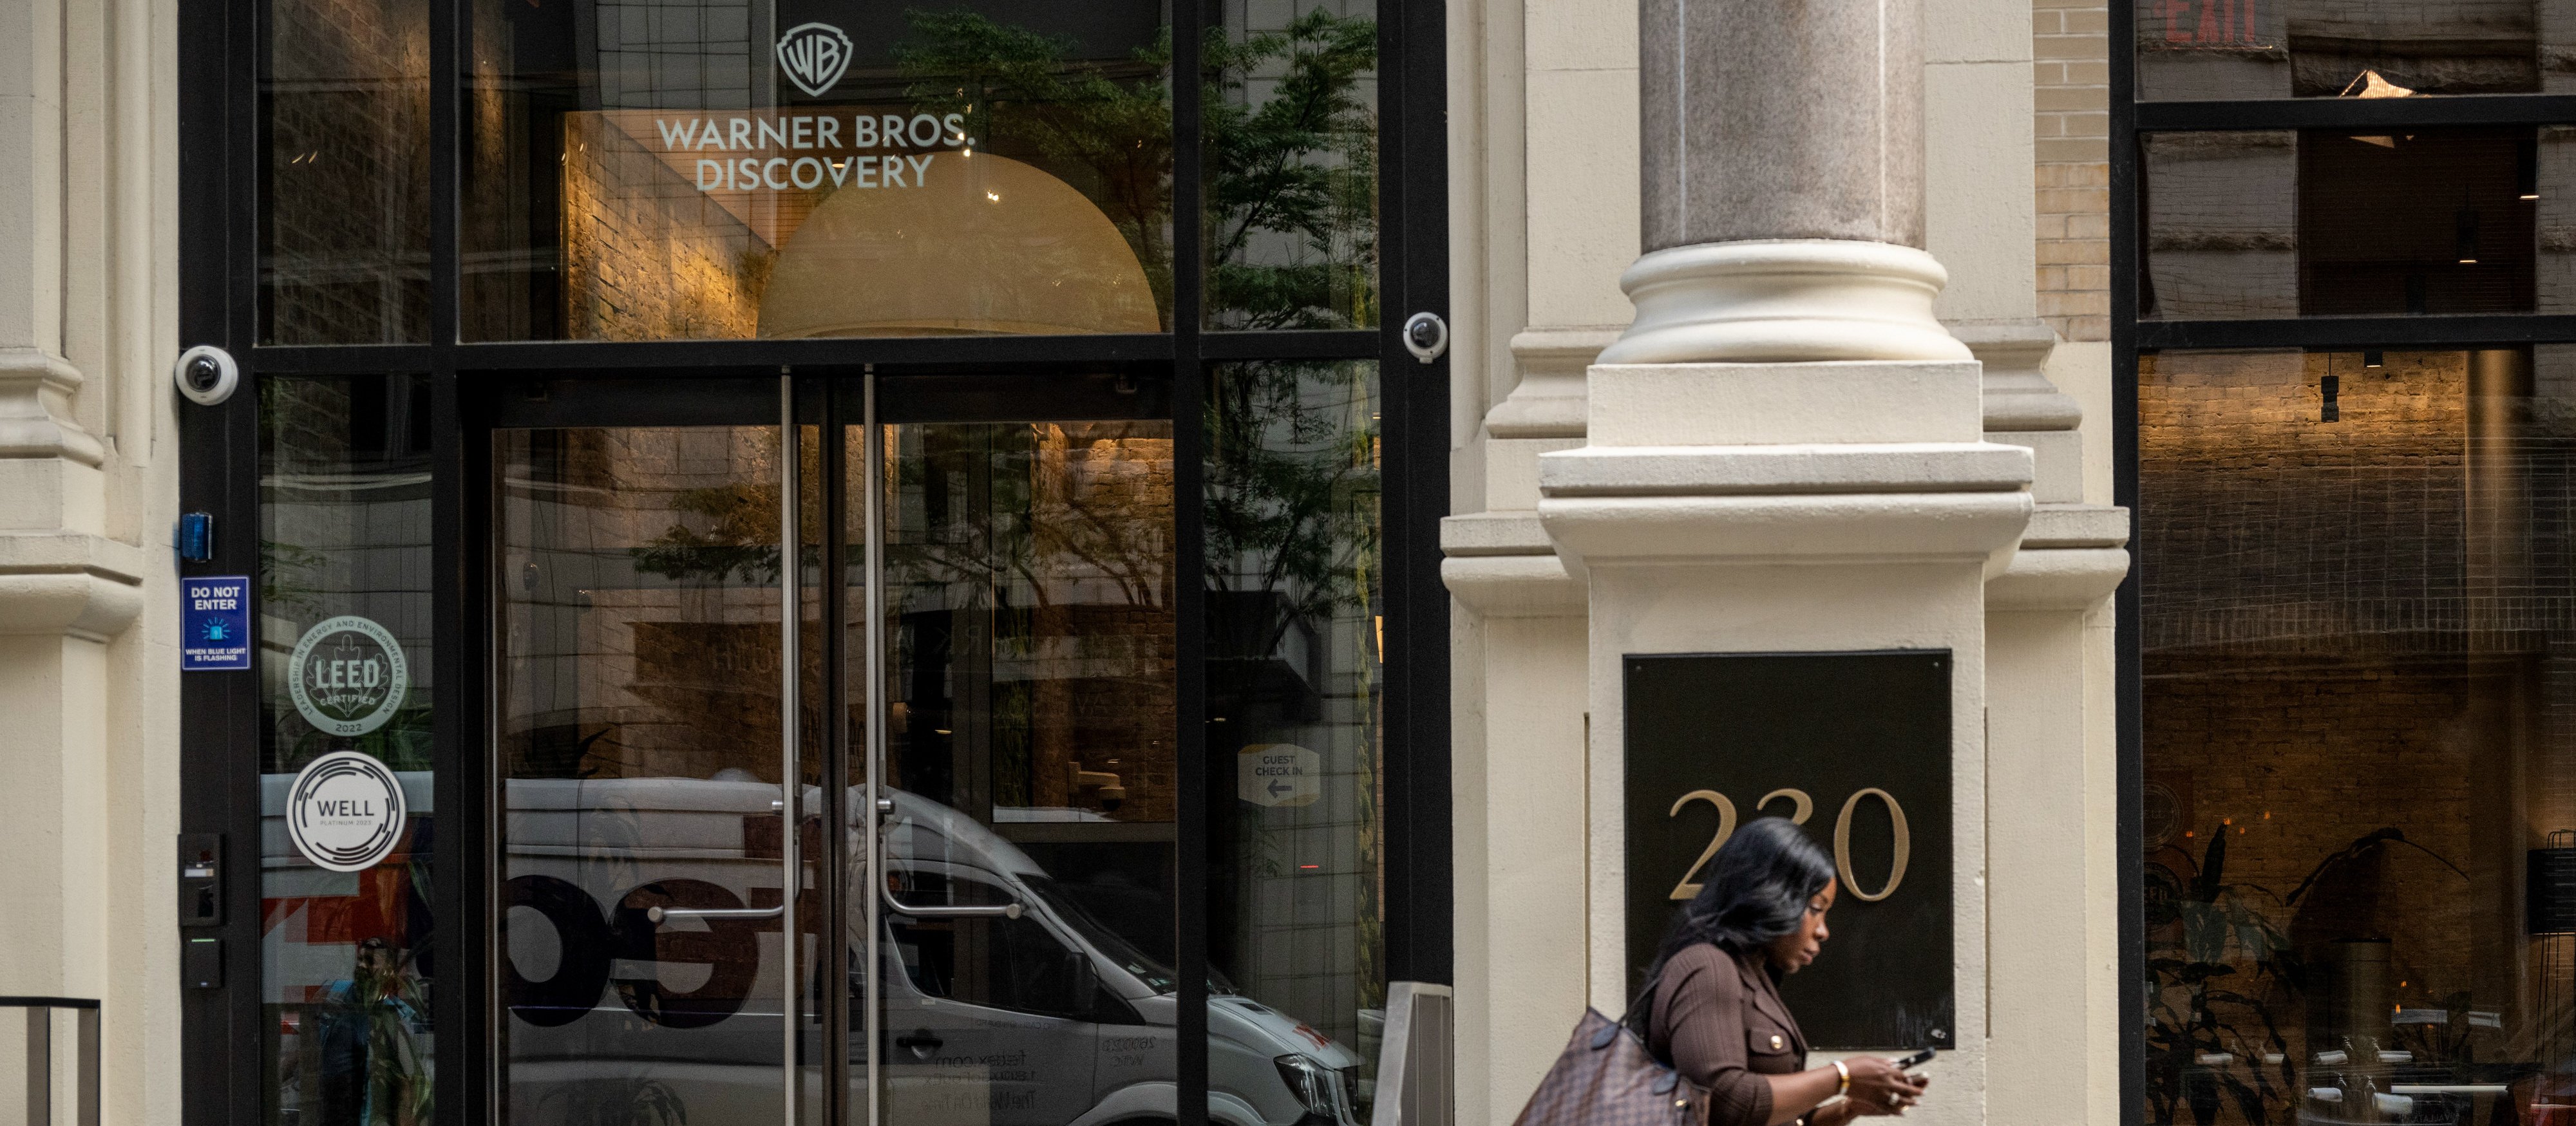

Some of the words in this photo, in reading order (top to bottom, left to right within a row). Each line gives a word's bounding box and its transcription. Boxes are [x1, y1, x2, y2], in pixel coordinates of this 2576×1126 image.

[656, 116, 842, 151] WARNER
[855, 113, 976, 147] BROS.
[697, 155, 934, 192] DISCOVERY
[191, 586, 210, 599] DO
[214, 586, 241, 598] NOT
[194, 599, 237, 611] ENTER
[303, 623, 333, 650] ENERGY
[298, 650, 305, 660] IN
[357, 621, 403, 680] ENVIRONMENTAL
[316, 659, 379, 689] LEED
[292, 661, 314, 716] LEADERSHIP
[319, 694, 376, 706] CERTIFIED
[383, 684, 402, 715] DESIGN
[335, 724, 363, 733] 2022
[1263, 755, 1296, 765] GUEST
[1256, 767, 1290, 776] CHECK
[1292, 767, 1303, 776] IN
[317, 800, 375, 817] WELL
